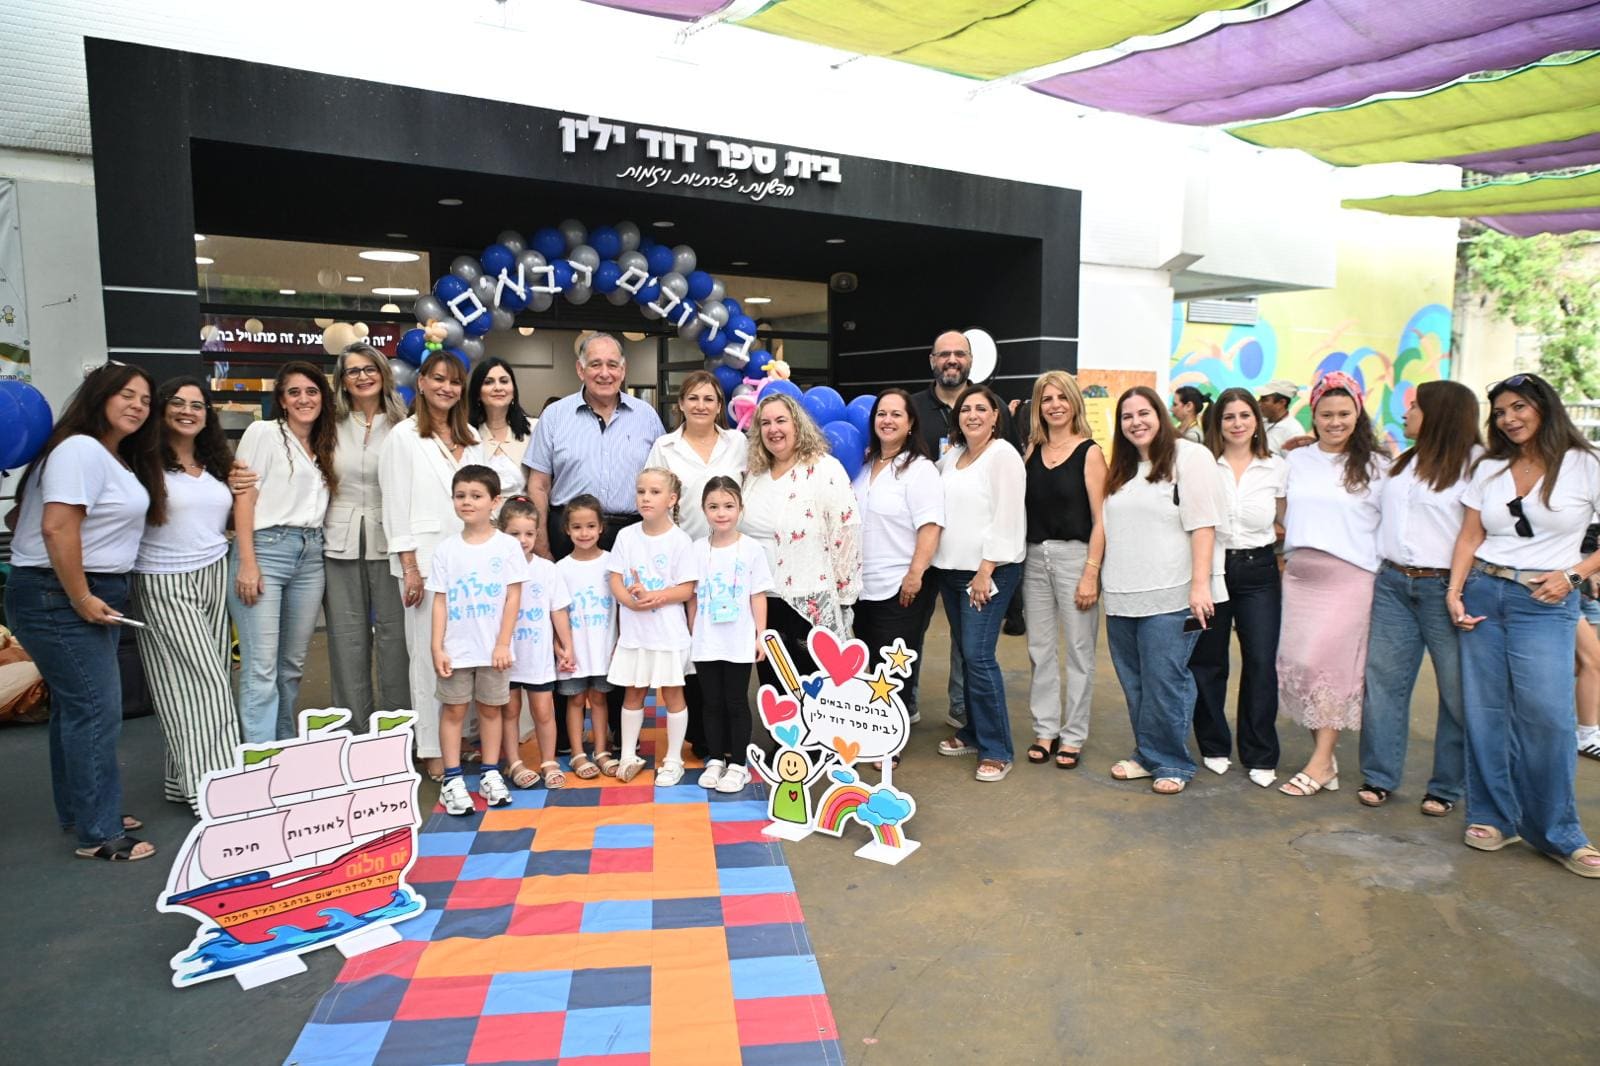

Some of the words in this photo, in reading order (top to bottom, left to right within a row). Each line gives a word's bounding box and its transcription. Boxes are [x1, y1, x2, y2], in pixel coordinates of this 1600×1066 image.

[558, 115, 626, 153] ילין
[636, 128, 698, 163] דוד
[706, 139, 776, 175] ספר
[784, 151, 842, 183] בית
[616, 165, 672, 188] ויזמות
[671, 172, 739, 189] יצירתיות
[279, 333, 294, 343] זה
[820, 697, 851, 710] הבאים
[810, 709, 826, 723] ילין
[854, 704, 889, 718] ברוכים
[829, 715, 846, 725] דוד
[849, 719, 868, 730] ספר
[871, 724, 898, 735] לבית
[353, 800, 408, 820] מפליגים
[287, 816, 345, 840] לאוצרות
[222, 842, 260, 858] חיפה
[345, 879, 373, 891] למידה
[376, 874, 394, 885] חקר
[279, 896, 312, 908] ברחבי
[252, 905, 276, 915] העיר
[224, 912, 249, 923] חיפה
